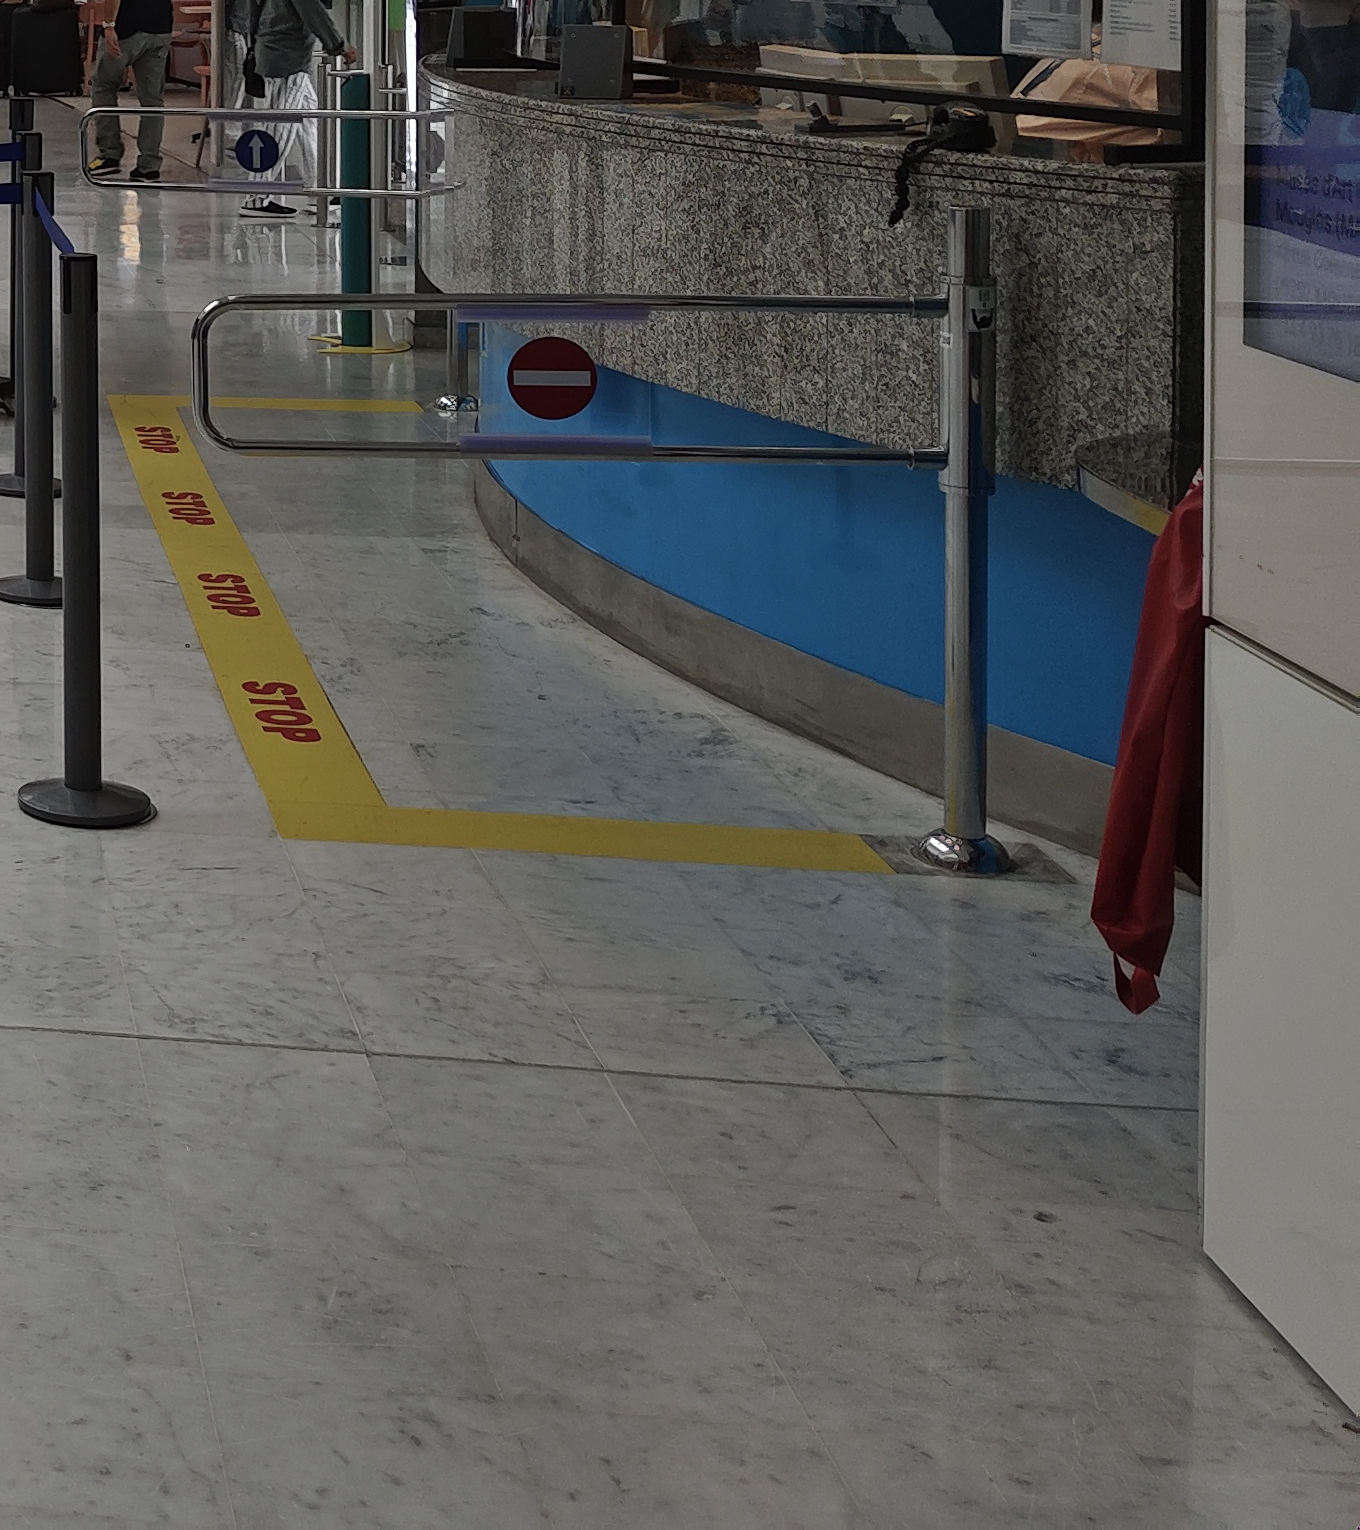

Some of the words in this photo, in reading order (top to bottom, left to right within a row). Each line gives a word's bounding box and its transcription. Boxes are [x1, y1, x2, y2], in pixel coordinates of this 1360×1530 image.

[133, 425, 180, 455] STOP
[160, 491, 216, 526] STOP
[196, 573, 261, 618] STOP
[241, 680, 323, 744] STOP
